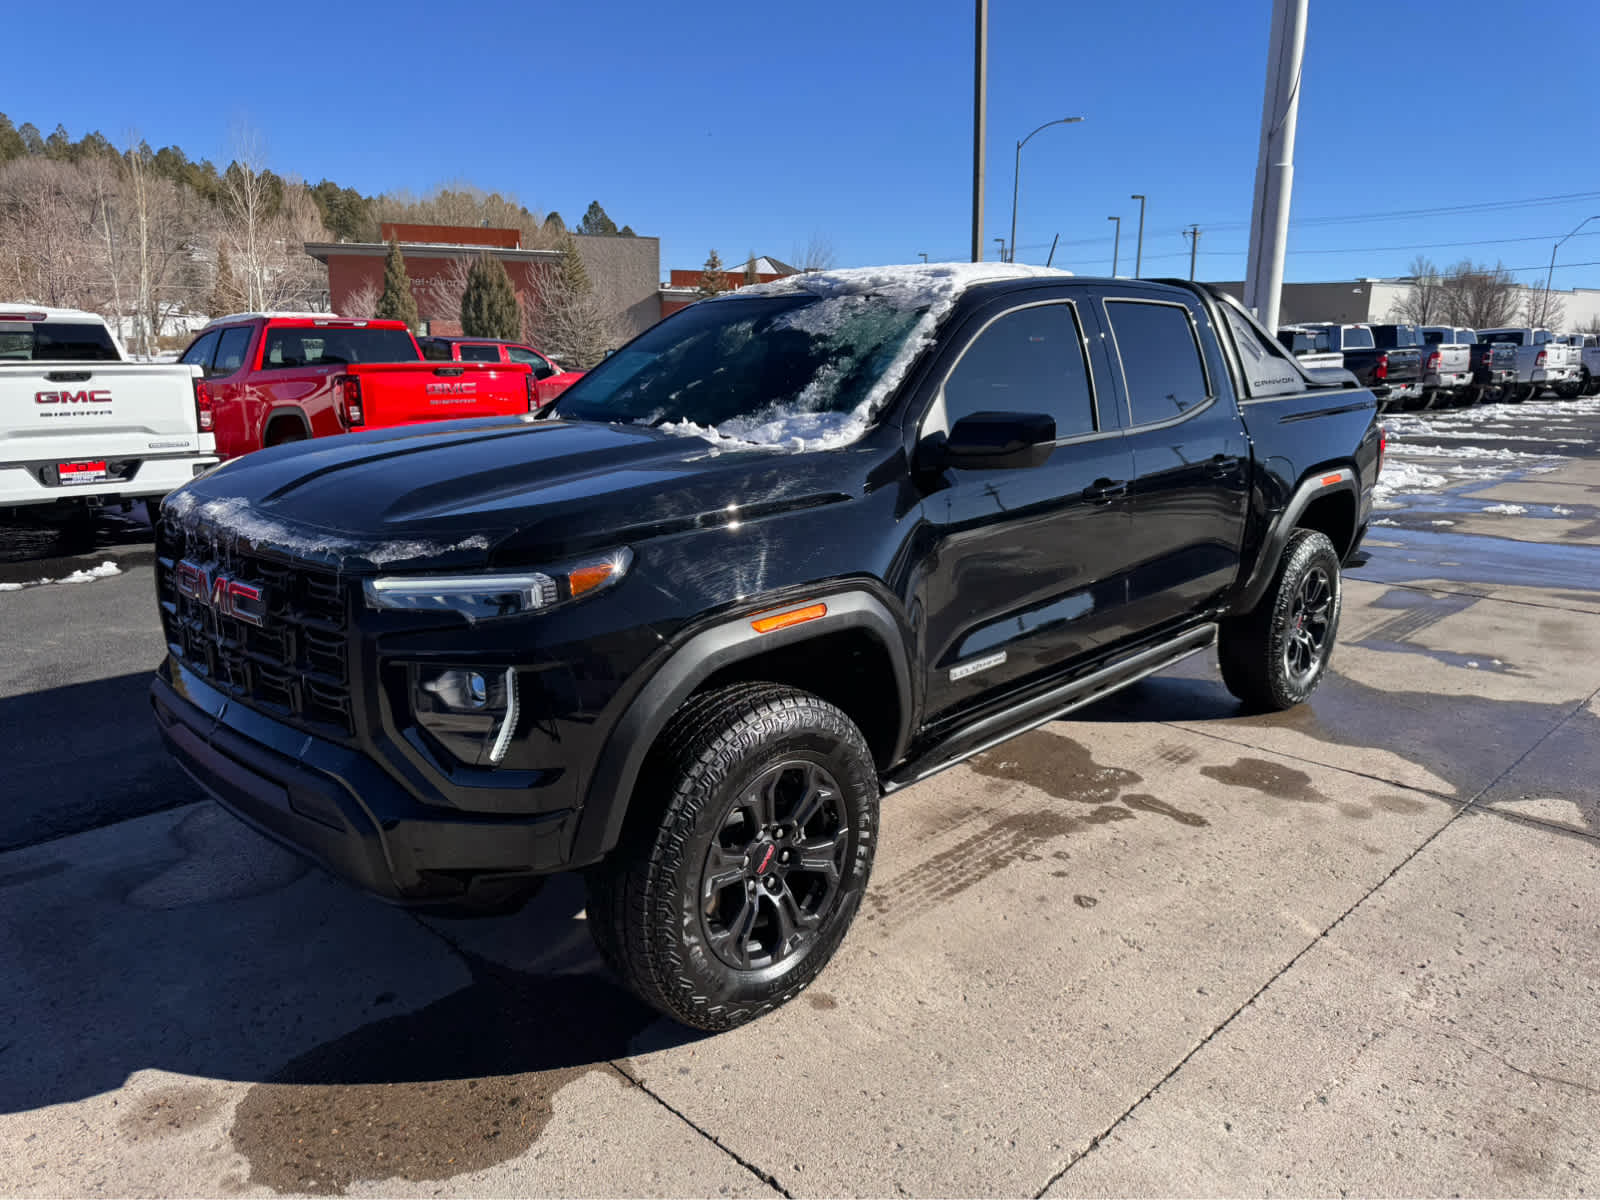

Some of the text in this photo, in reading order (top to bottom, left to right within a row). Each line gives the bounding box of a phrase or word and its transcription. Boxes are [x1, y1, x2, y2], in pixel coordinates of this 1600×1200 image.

[425, 382, 477, 395] GMC
[1254, 376, 1294, 388] CANYON
[35, 390, 112, 404] GMC
[176, 559, 265, 628] GMC
